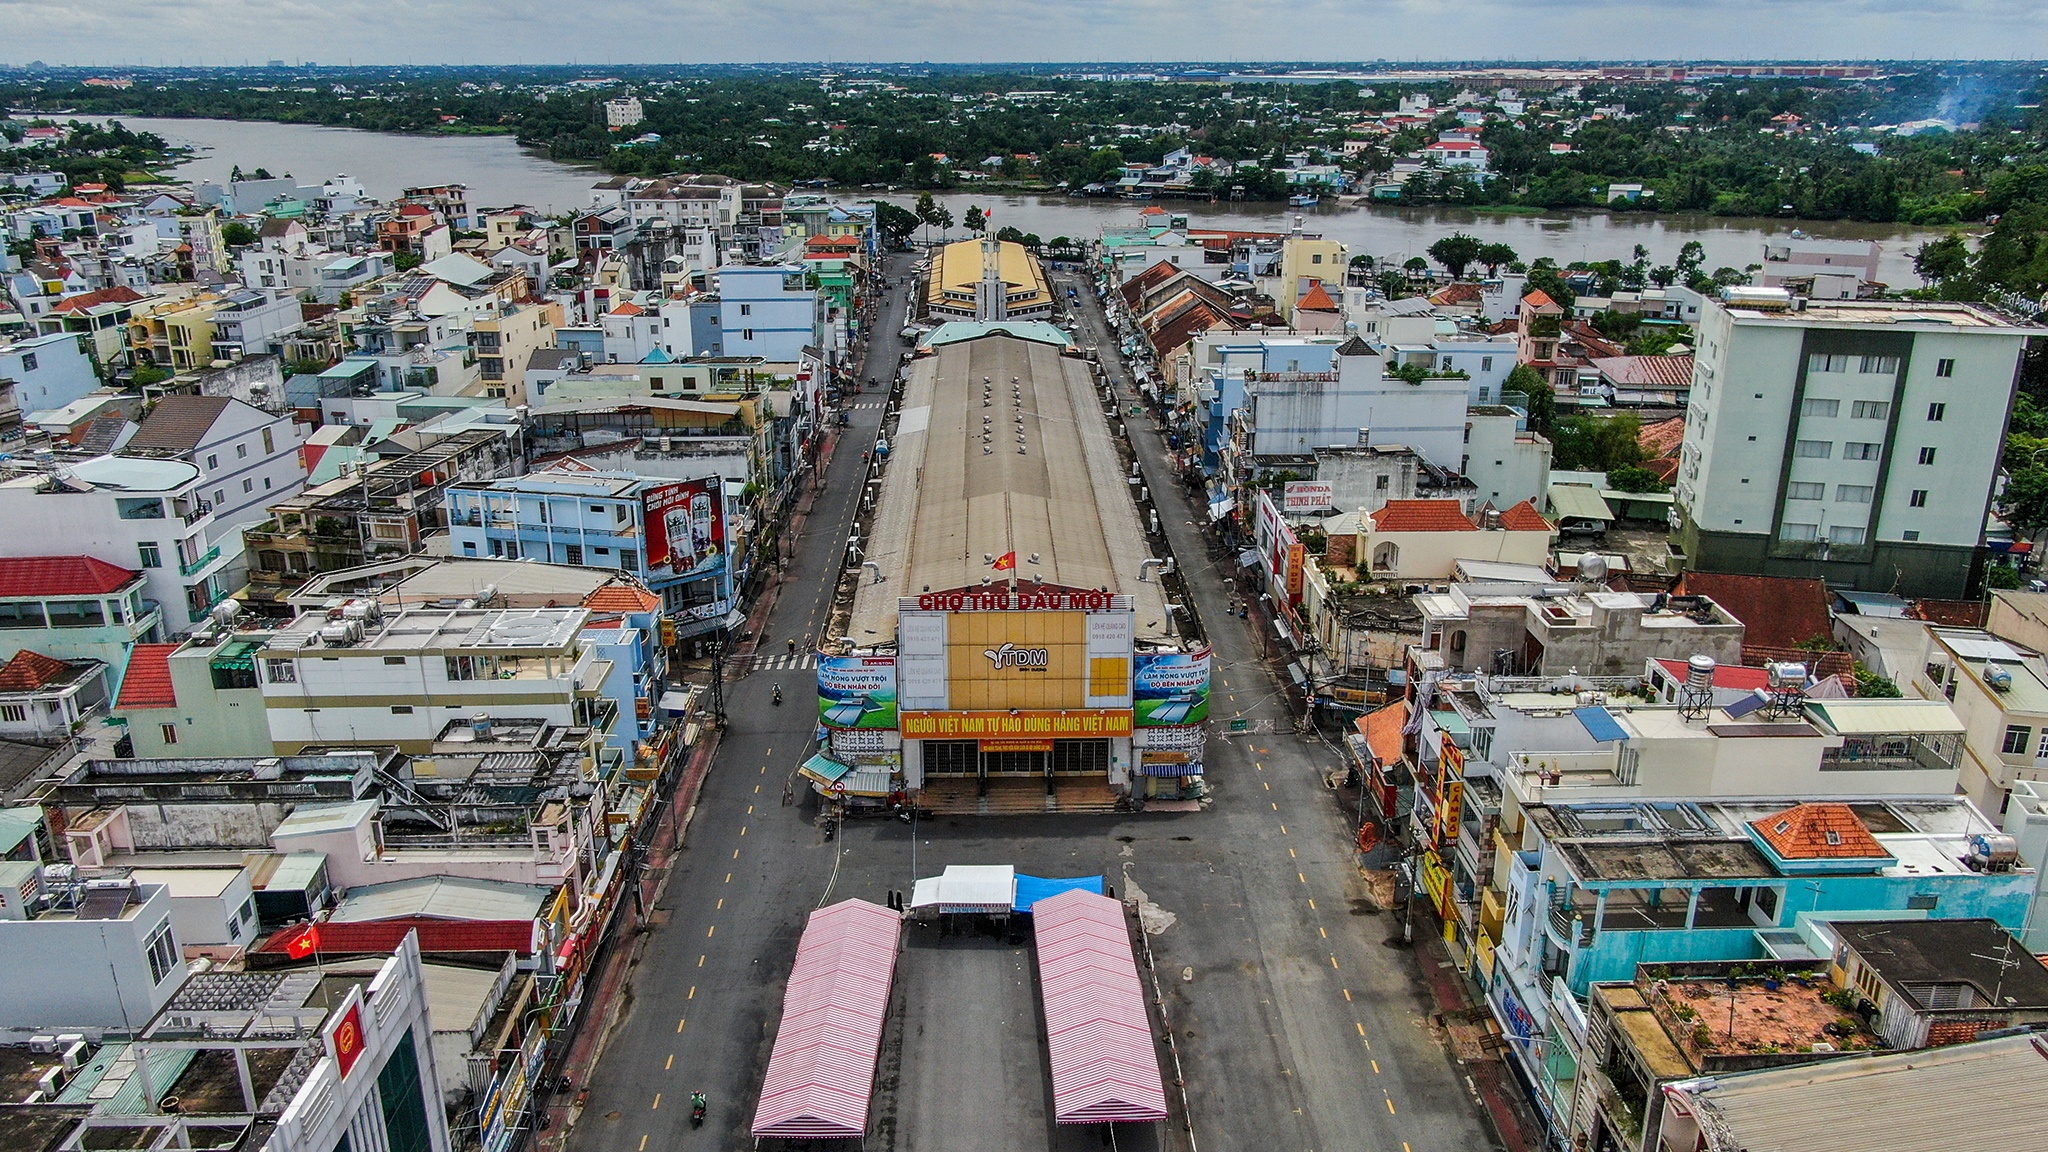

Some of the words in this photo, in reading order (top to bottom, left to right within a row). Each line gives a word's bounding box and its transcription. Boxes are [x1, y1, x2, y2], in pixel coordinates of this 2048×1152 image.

[1286, 496, 1309, 509] THỊNH
[1311, 493, 1331, 506] PHÁT
[919, 592, 964, 614] CHỢ
[969, 586, 1010, 610] THỦ
[1018, 585, 1062, 610] DẦU
[1069, 588, 1115, 612] MỘT
[906, 715, 936, 733] NGƯỜI
[939, 715, 959, 736] VIỆT
[962, 718, 984, 733] NAM
[987, 716, 1000, 736] TỰ
[1002, 715, 1021, 732] HÀO
[1024, 714, 1051, 732] DÙNG
[1053, 714, 1080, 732] HÀNG
[1083, 713, 1103, 734] VIỆT
[1106, 716, 1129, 731] NAM
